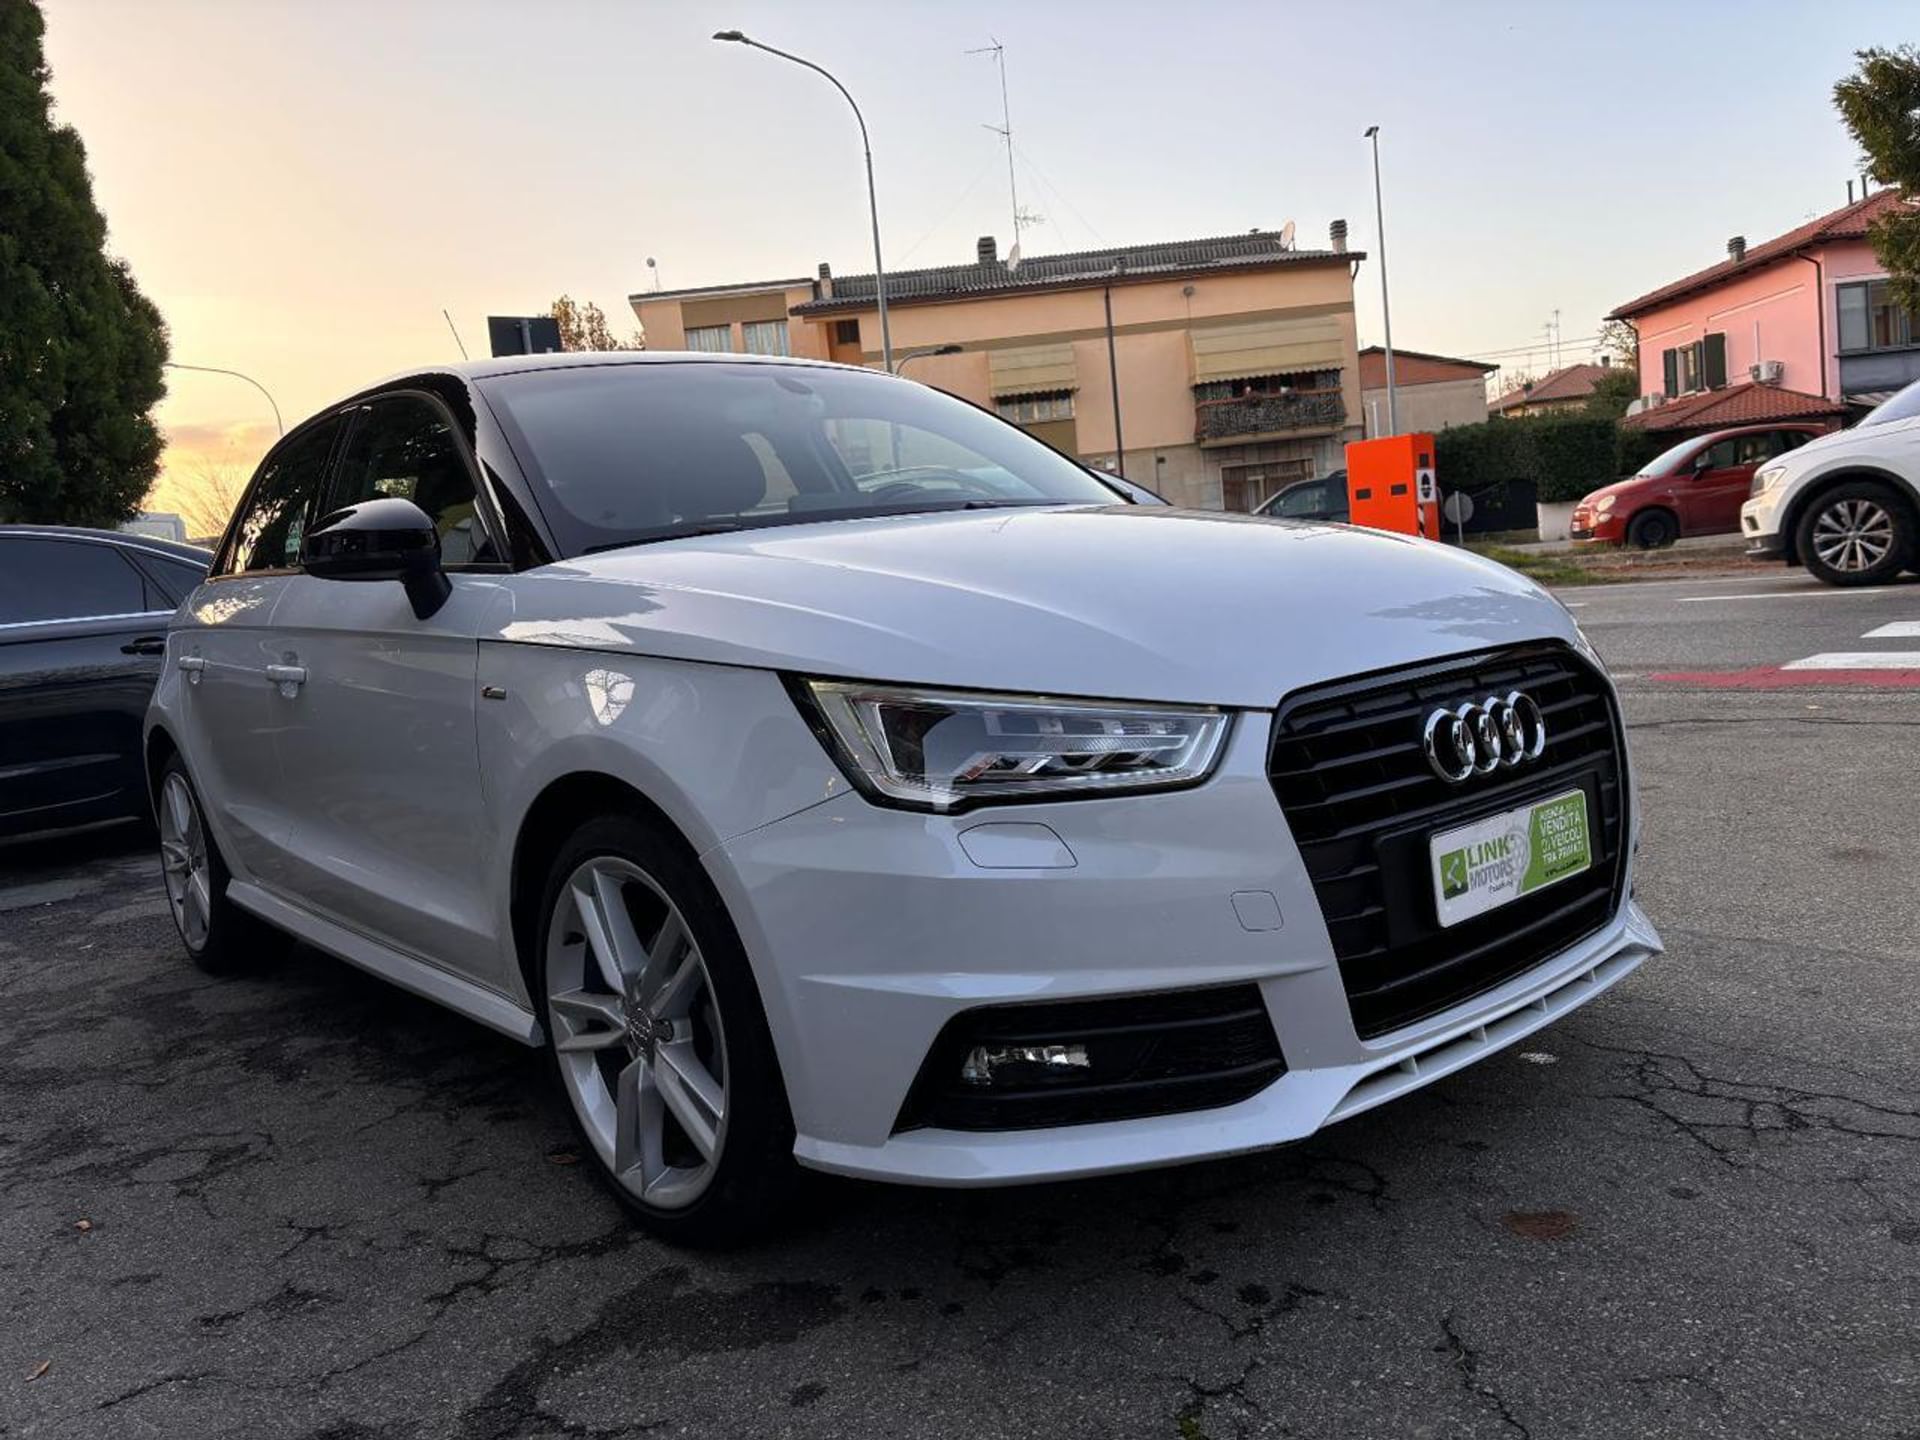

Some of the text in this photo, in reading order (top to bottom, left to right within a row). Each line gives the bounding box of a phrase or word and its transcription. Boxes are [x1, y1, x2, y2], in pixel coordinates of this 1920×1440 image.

[1540, 810, 1583, 837] VENDITA
[1466, 835, 1511, 869] LINK
[1469, 859, 1514, 890] MOTORS
